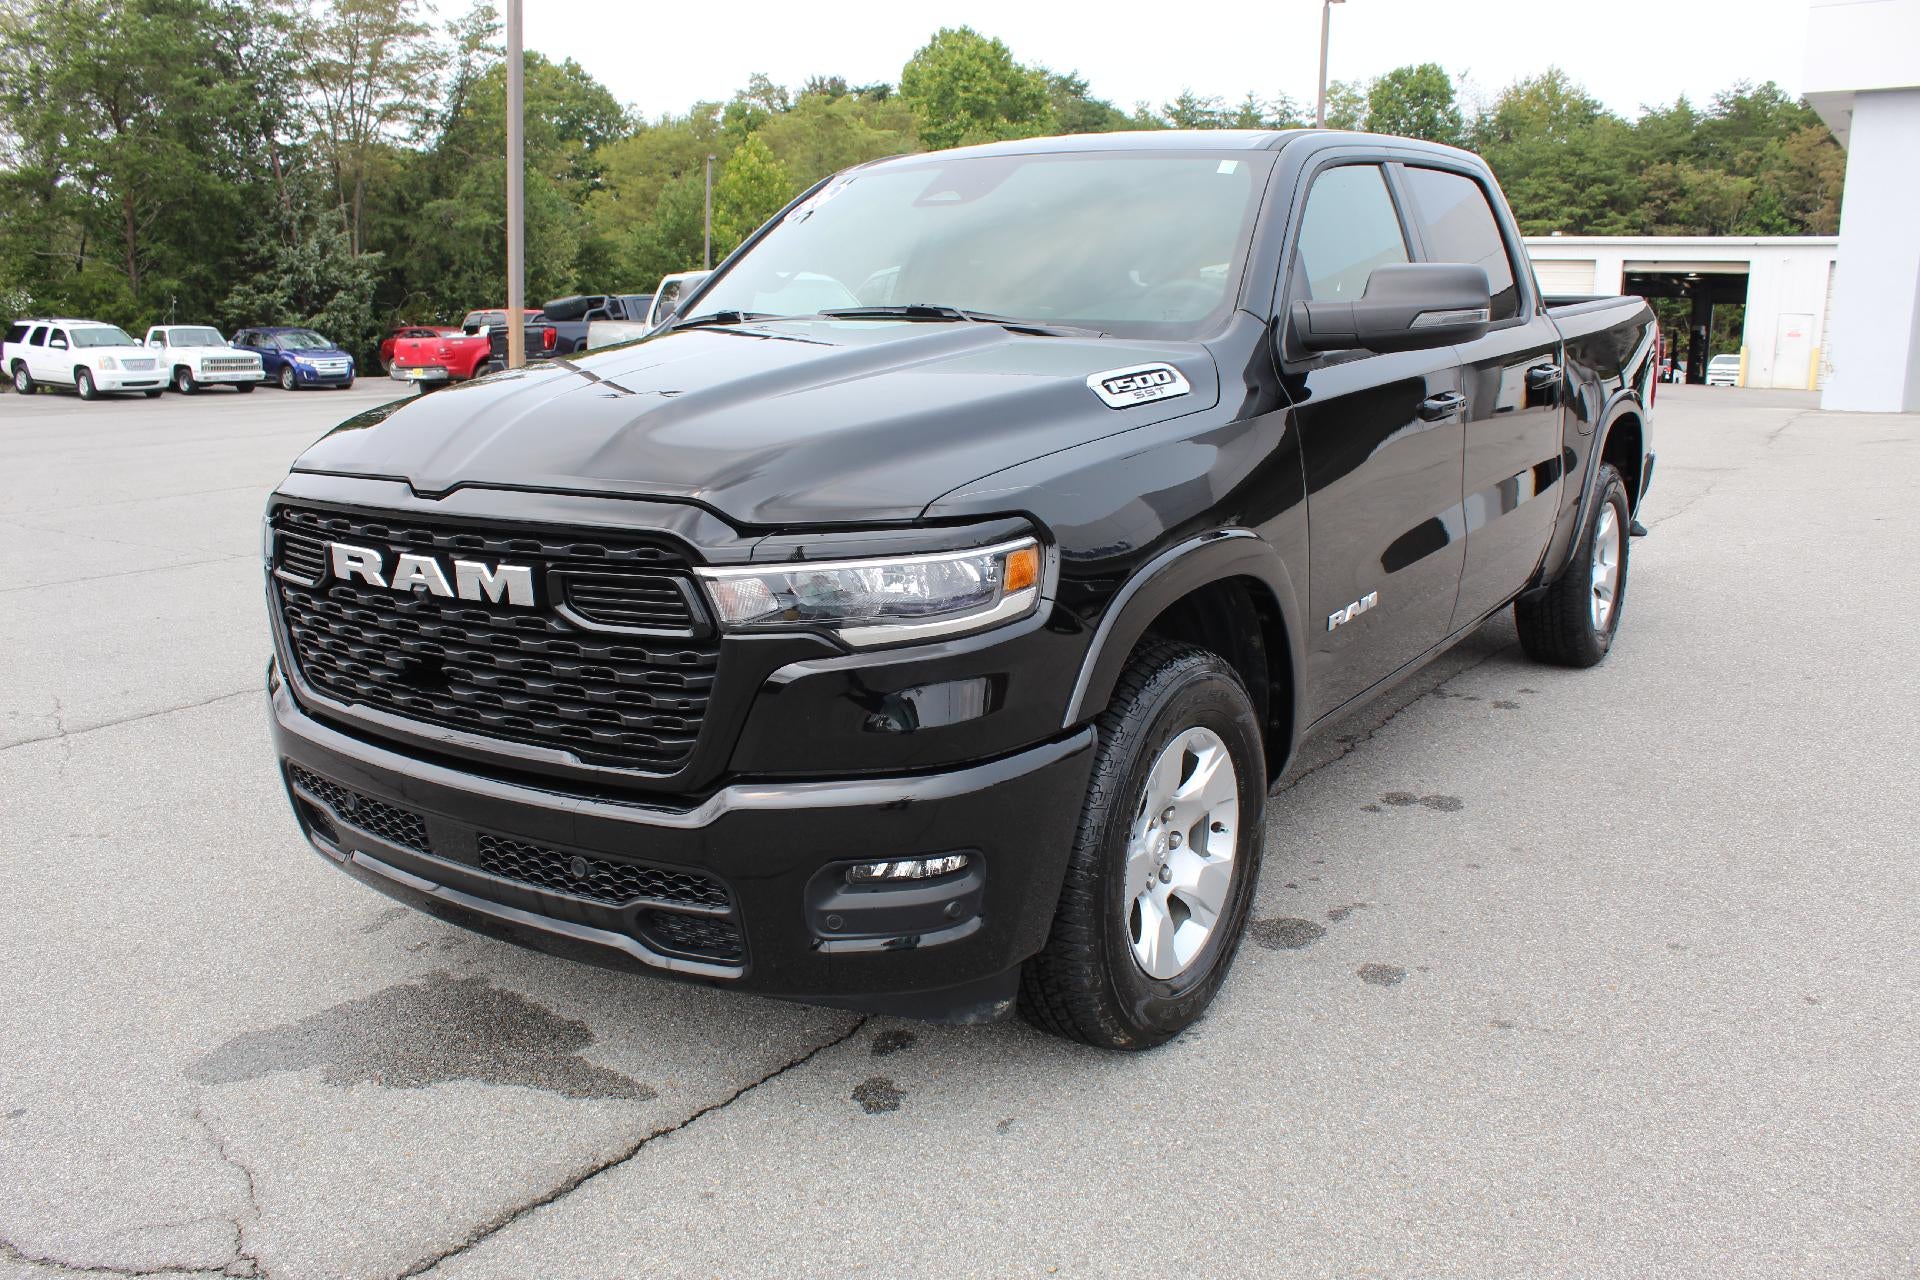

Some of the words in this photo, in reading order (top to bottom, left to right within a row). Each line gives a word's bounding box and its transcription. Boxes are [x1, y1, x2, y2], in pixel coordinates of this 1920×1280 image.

[1104, 370, 1171, 394] 1500
[1133, 387, 1165, 399] SST
[331, 542, 534, 606] RAM
[1328, 591, 1377, 631] RAM
